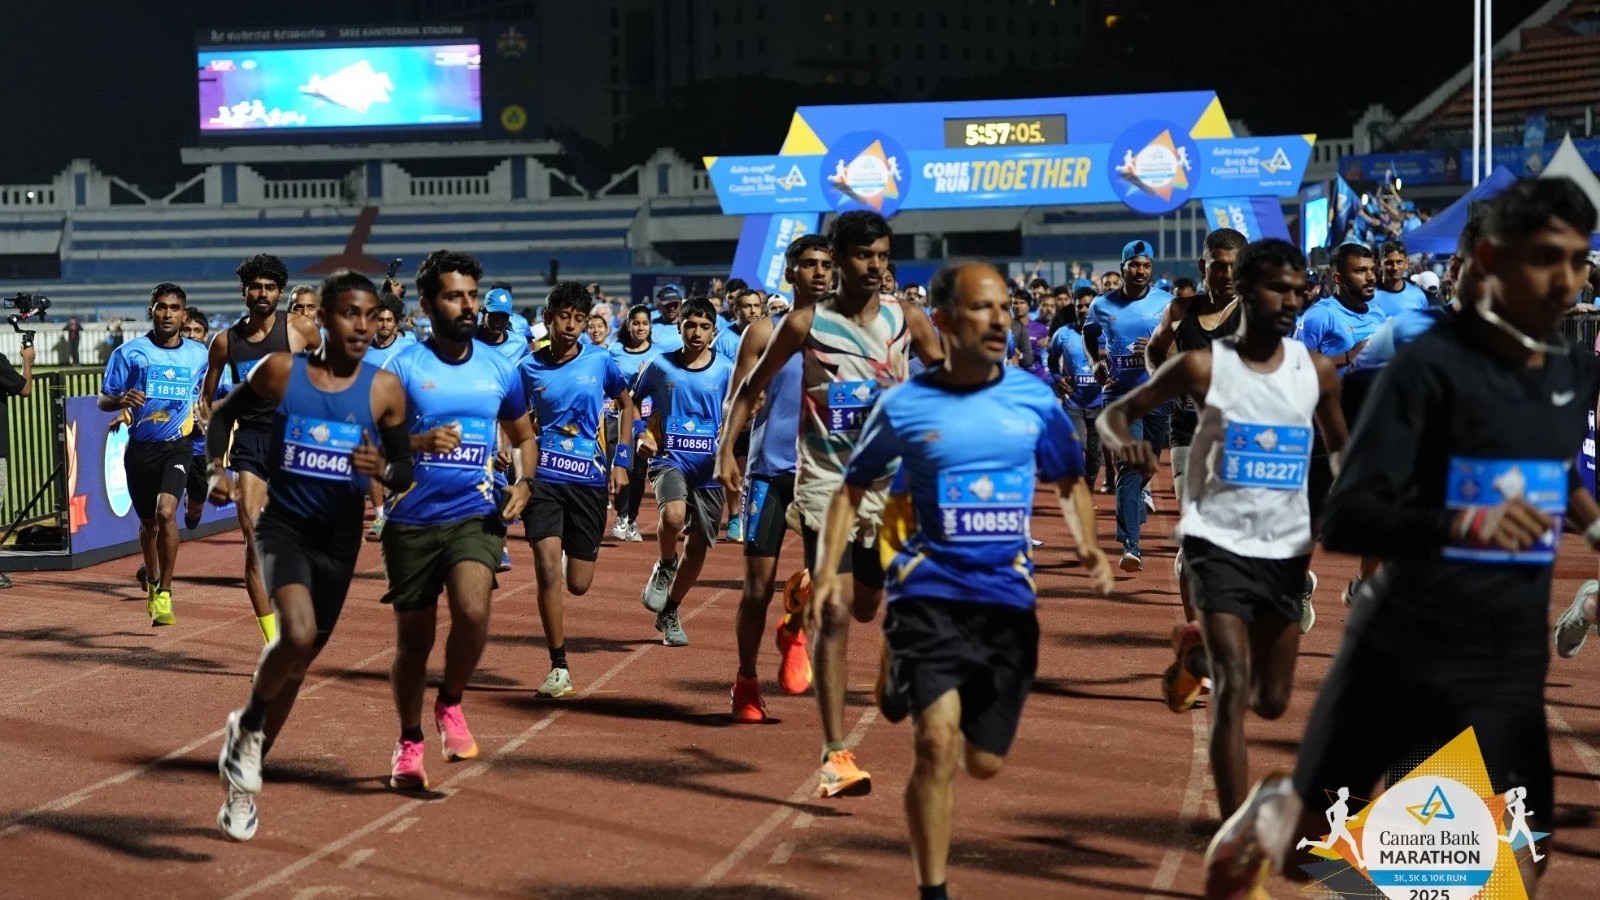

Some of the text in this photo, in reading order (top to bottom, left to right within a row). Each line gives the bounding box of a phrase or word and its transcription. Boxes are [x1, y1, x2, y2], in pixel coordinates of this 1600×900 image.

[922, 161, 970, 179] COME
[970, 156, 1091, 192] TOGETHER
[935, 175, 970, 193] RUN
[765, 252, 785, 289] FEEL
[775, 217, 794, 249] THE
[1124, 357, 1144, 367] 1118
[157, 385, 186, 396] 18138
[831, 408, 843, 430] 10K
[666, 434, 675, 449] 10K
[676, 438, 708, 450] 10856
[283, 443, 296, 467] 10K
[297, 450, 349, 473] 10646
[540, 451, 550, 467] 10K
[551, 456, 586, 474] 10900
[1245, 460, 1298, 481] 18227
[942, 508, 958, 535] 10K
[961, 510, 1019, 533] 10855
